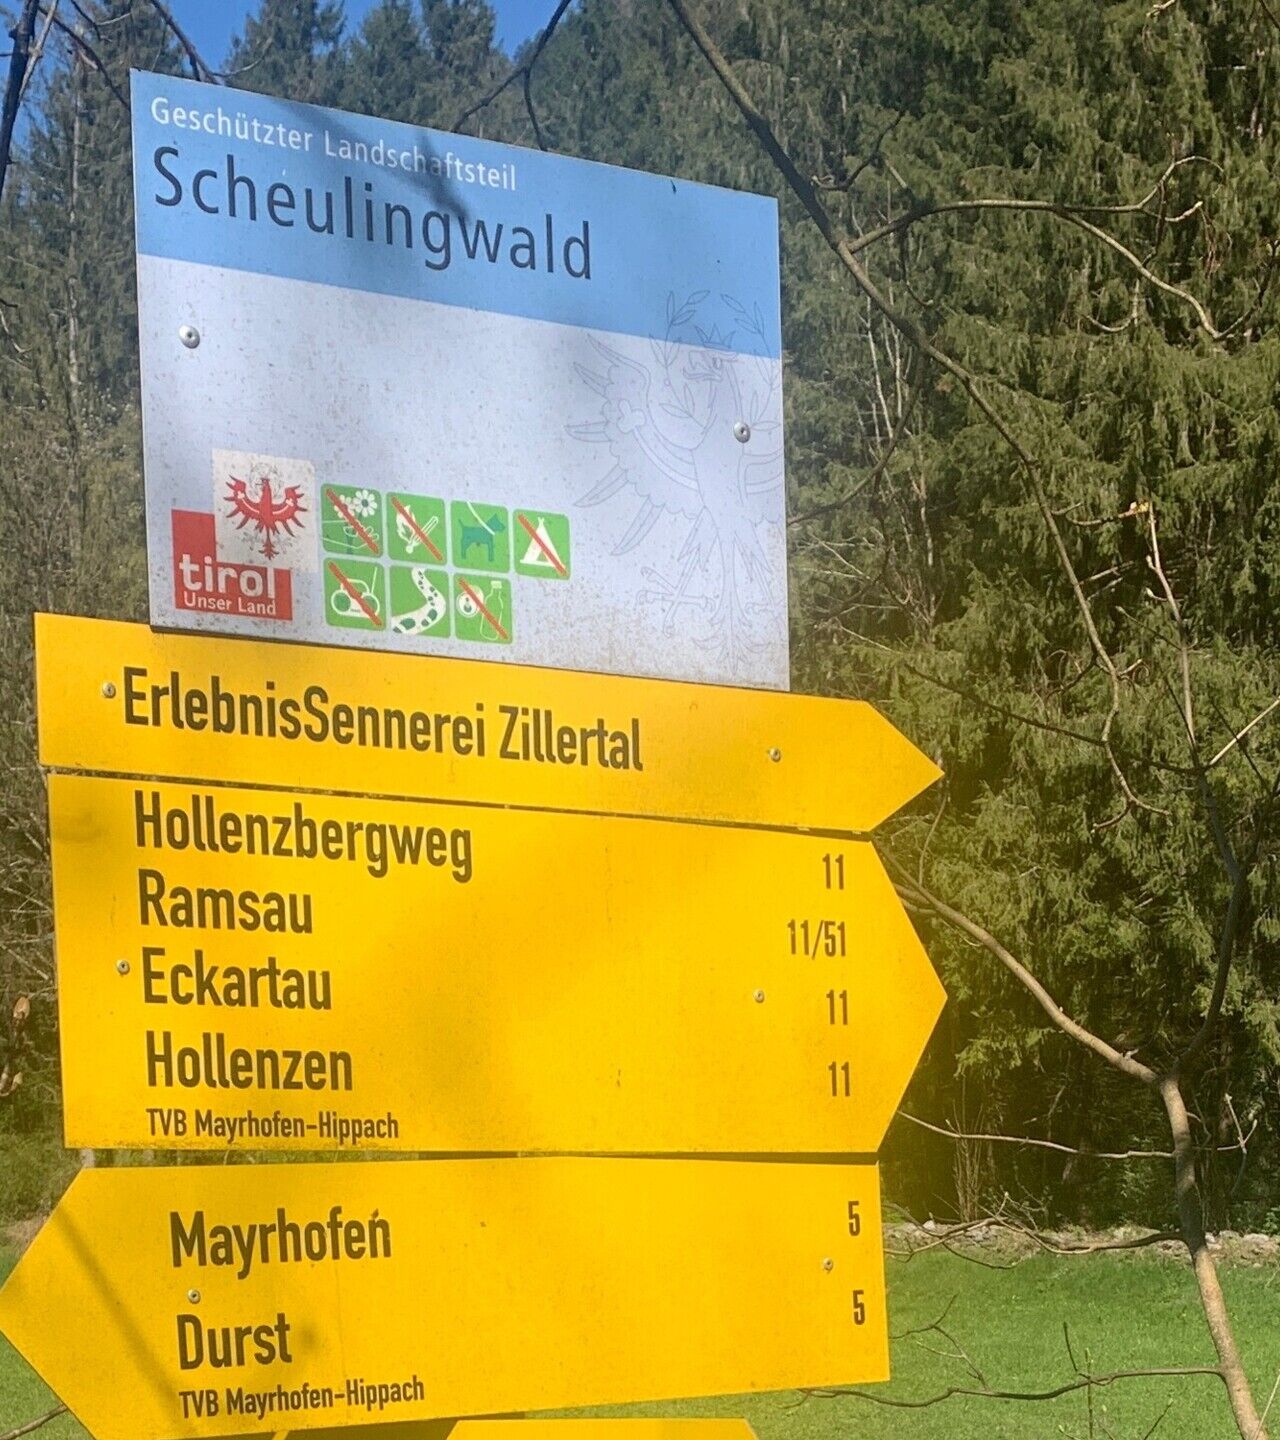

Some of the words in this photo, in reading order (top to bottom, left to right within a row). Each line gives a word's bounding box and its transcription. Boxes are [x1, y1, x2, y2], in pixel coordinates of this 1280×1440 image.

[151, 96, 313, 152] Geschützter
[326, 131, 517, 191] Landschaftsteil
[153, 146, 592, 280] Scheulingwald
[179, 554, 276, 599] tirol
[183, 591, 232, 610] Unser
[238, 597, 276, 615] Land
[123, 667, 486, 752] ErlebnisSennerei
[499, 704, 643, 771] Zillertal
[135, 791, 472, 884] Hollenzbergweg
[823, 853, 845, 890] 11
[138, 869, 313, 933] Ramsau
[787, 919, 846, 959] 11/51
[142, 947, 332, 1010] Eckartau
[827, 990, 849, 1025] 11
[146, 1031, 352, 1091] Hollenzen
[828, 1061, 851, 1097] 11
[146, 1108, 187, 1137] TVB
[195, 1109, 399, 1145] Mayrhofen-Hippach
[170, 1206, 391, 1280] Mayrhofen
[848, 1201, 861, 1236] 5
[177, 1313, 292, 1370] Durst
[852, 1290, 866, 1325] 5
[179, 1390, 219, 1418] TVB
[226, 1375, 424, 1420] Mayrhofen-Hippach
